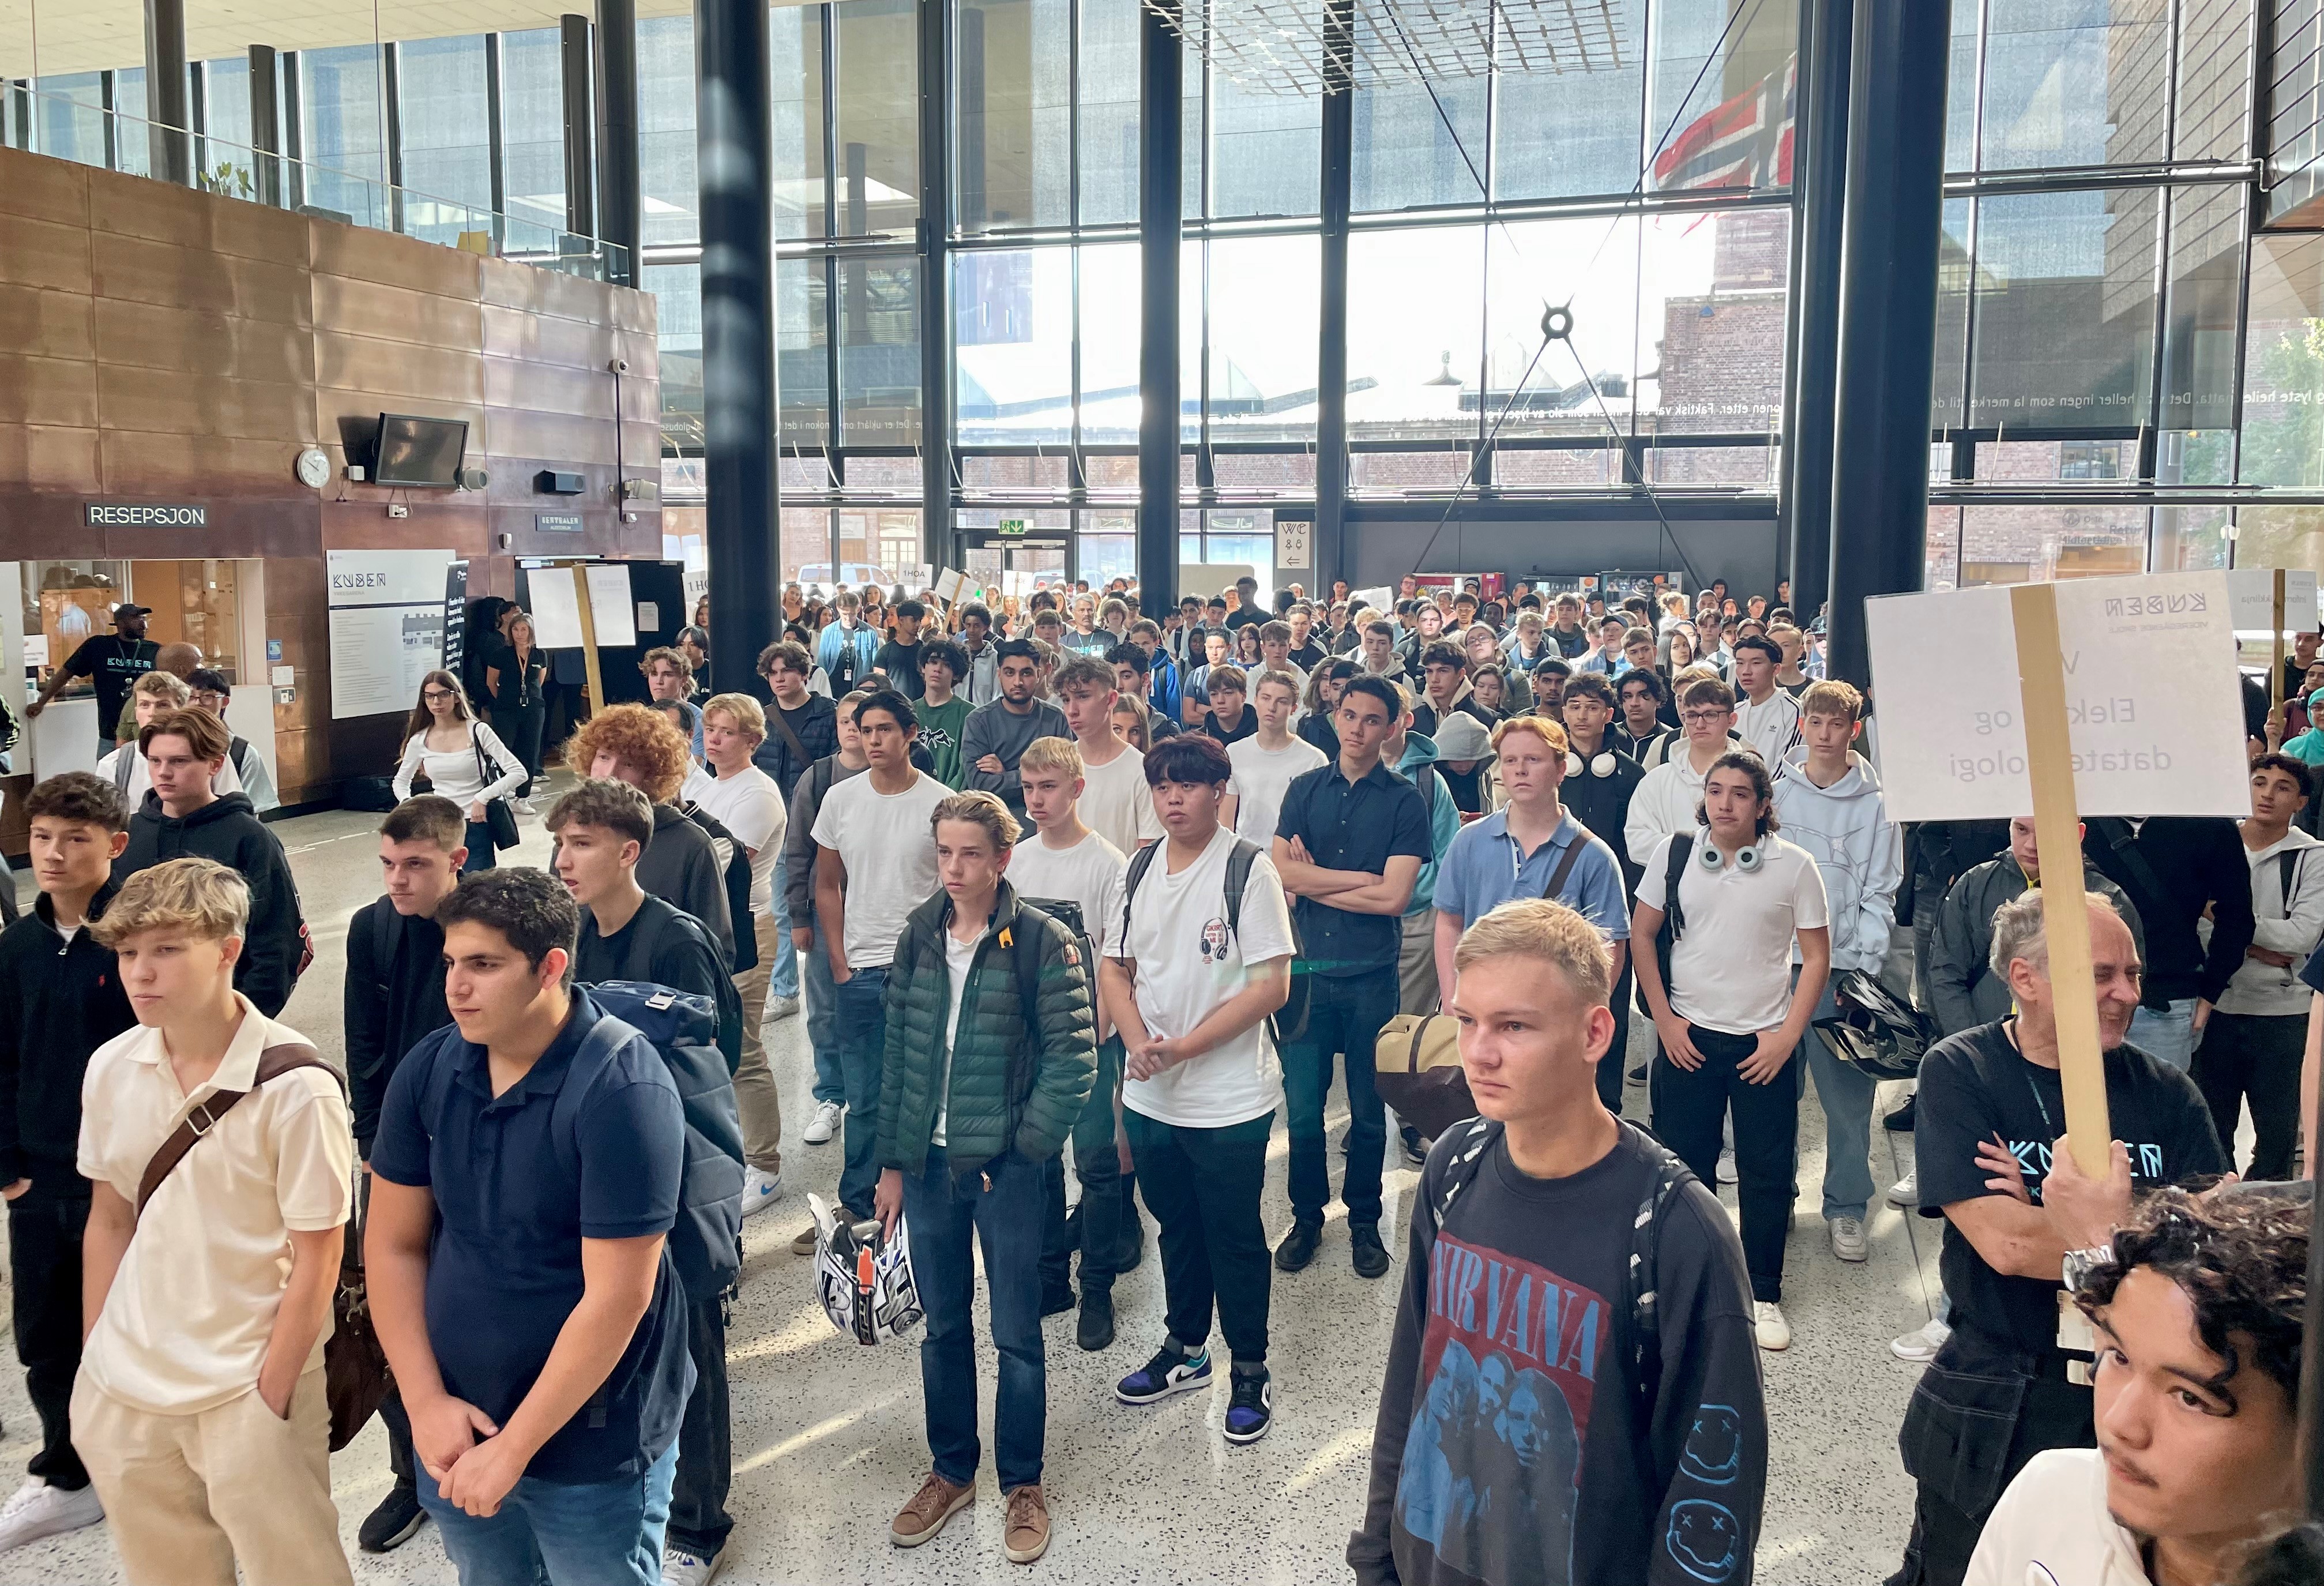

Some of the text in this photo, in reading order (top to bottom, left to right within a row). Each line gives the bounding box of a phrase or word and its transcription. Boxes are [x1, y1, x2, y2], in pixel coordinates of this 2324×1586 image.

[90, 506, 204, 524] RESEPSJON
[333, 573, 386, 588] KUBEN
[1431, 1239, 1601, 1383] NIRVANA
